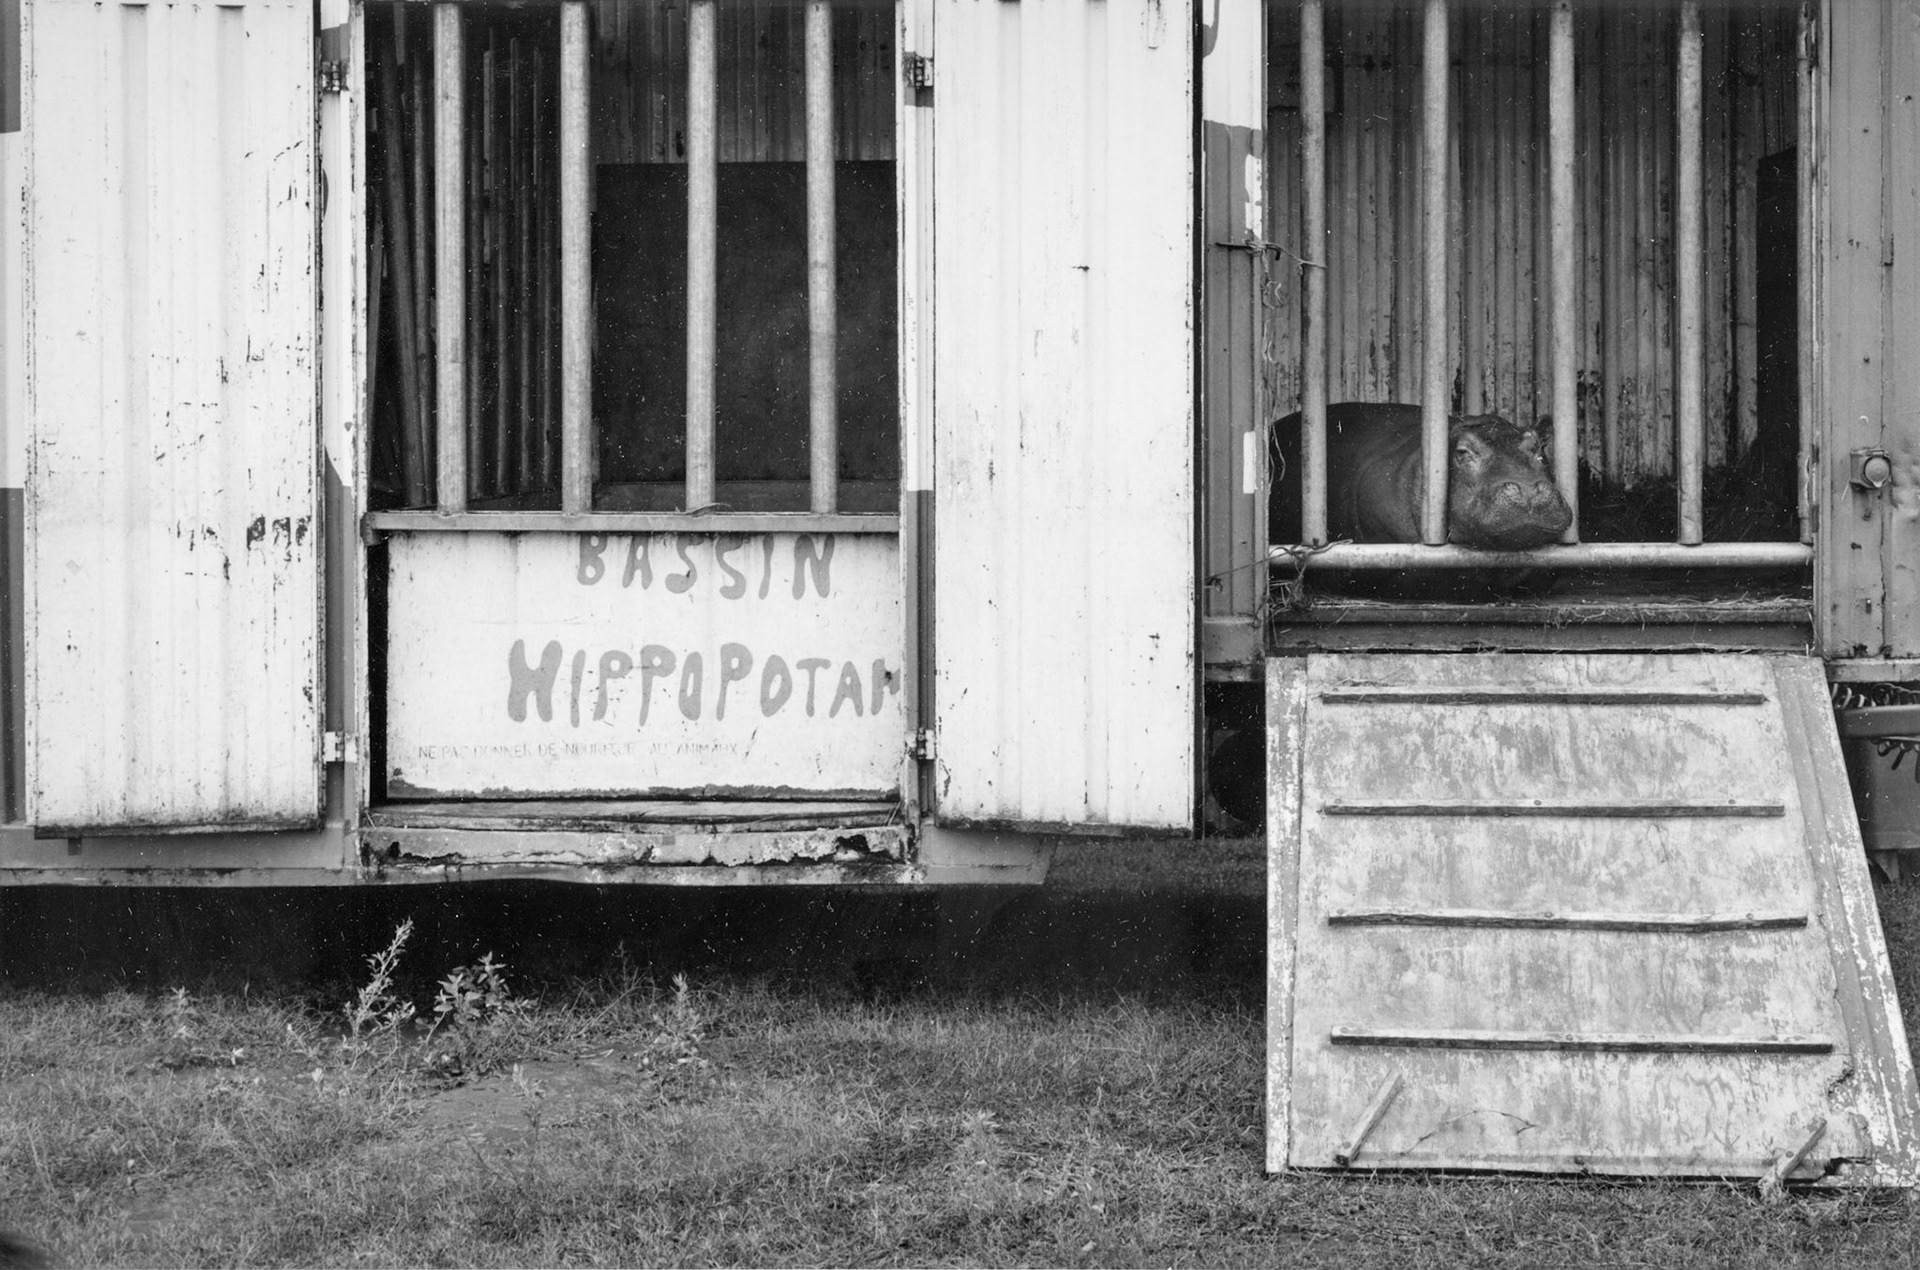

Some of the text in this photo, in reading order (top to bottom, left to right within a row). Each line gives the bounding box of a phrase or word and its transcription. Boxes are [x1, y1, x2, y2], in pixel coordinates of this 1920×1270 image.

[577, 532, 835, 600] BASSIN
[418, 744, 438, 760] NE
[538, 742, 557, 759] DE
